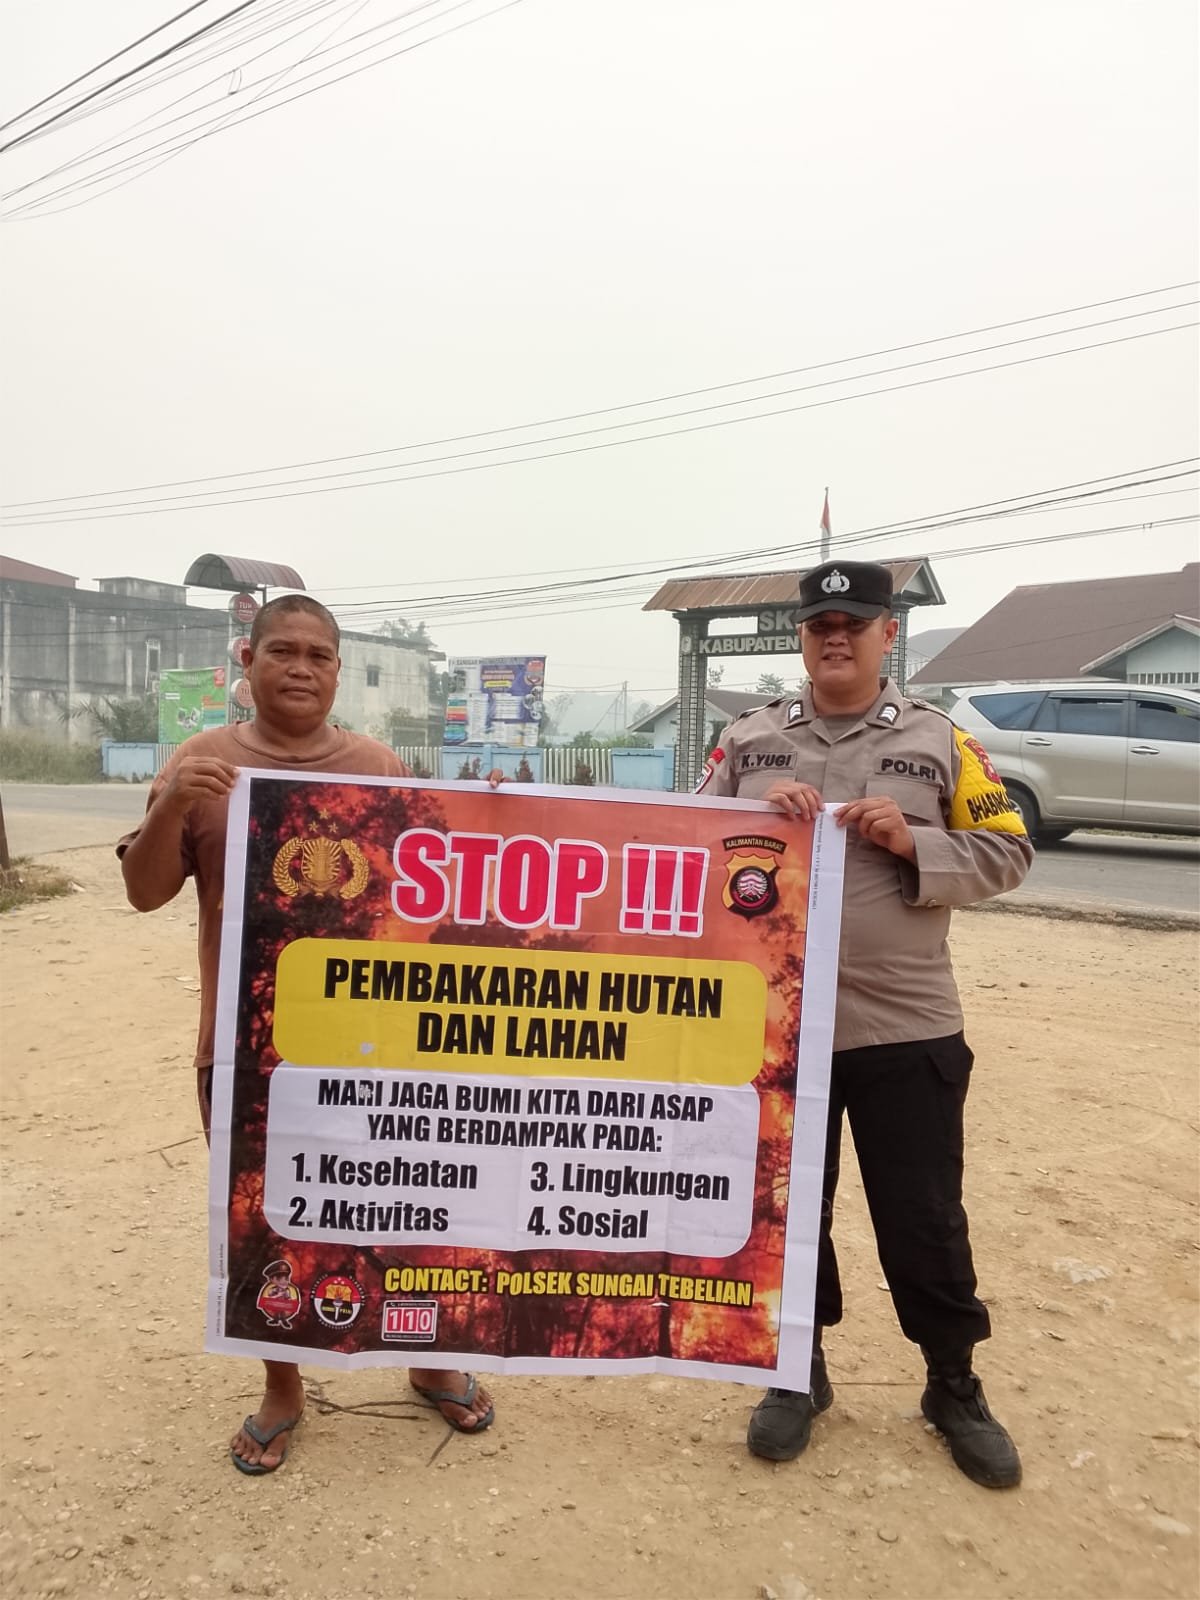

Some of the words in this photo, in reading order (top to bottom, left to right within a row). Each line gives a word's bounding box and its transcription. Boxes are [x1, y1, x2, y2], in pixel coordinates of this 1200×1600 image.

[759, 609, 800, 631] SK
[699, 635, 800, 653] KABUPATEN
[741, 754, 792, 768] K.YUGI
[881, 758, 937, 781] POLRI
[726, 837, 763, 849] KALIMANTAN
[763, 839, 784, 851] BARAT
[391, 828, 609, 930] STOP
[619, 843, 710, 937] !!!
[324, 958, 589, 1010] PEMBAKARAN
[599, 972, 722, 1018] HUTAN
[416, 1012, 495, 1055] DAN
[505, 1016, 627, 1060] LAHAN
[318, 1079, 383, 1106] MARI
[389, 1082, 448, 1110] JAGA
[455, 1085, 521, 1115] BUMI
[527, 1089, 581, 1116] KITA
[587, 1091, 645, 1119] DARI
[650, 1094, 713, 1122] ASAP
[368, 1114, 430, 1142] YANG
[437, 1117, 587, 1149] BERDAMPAK
[592, 1124, 662, 1152] PADA:
[291, 1153, 312, 1183] 1.
[319, 1154, 477, 1189] Kesehatan
[530, 1162, 555, 1192] 3.
[562, 1163, 730, 1201] Lingkungan
[288, 1196, 313, 1227] 2.
[319, 1199, 449, 1232] Aktivitas
[527, 1206, 551, 1236] 4.
[558, 1205, 649, 1239] Sosial
[384, 1268, 488, 1292] CONTACT:
[496, 1271, 573, 1296] POLSEK
[576, 1272, 654, 1297] SUNGAI
[658, 1273, 752, 1306] TEBELIAN
[389, 1310, 432, 1331] 110
